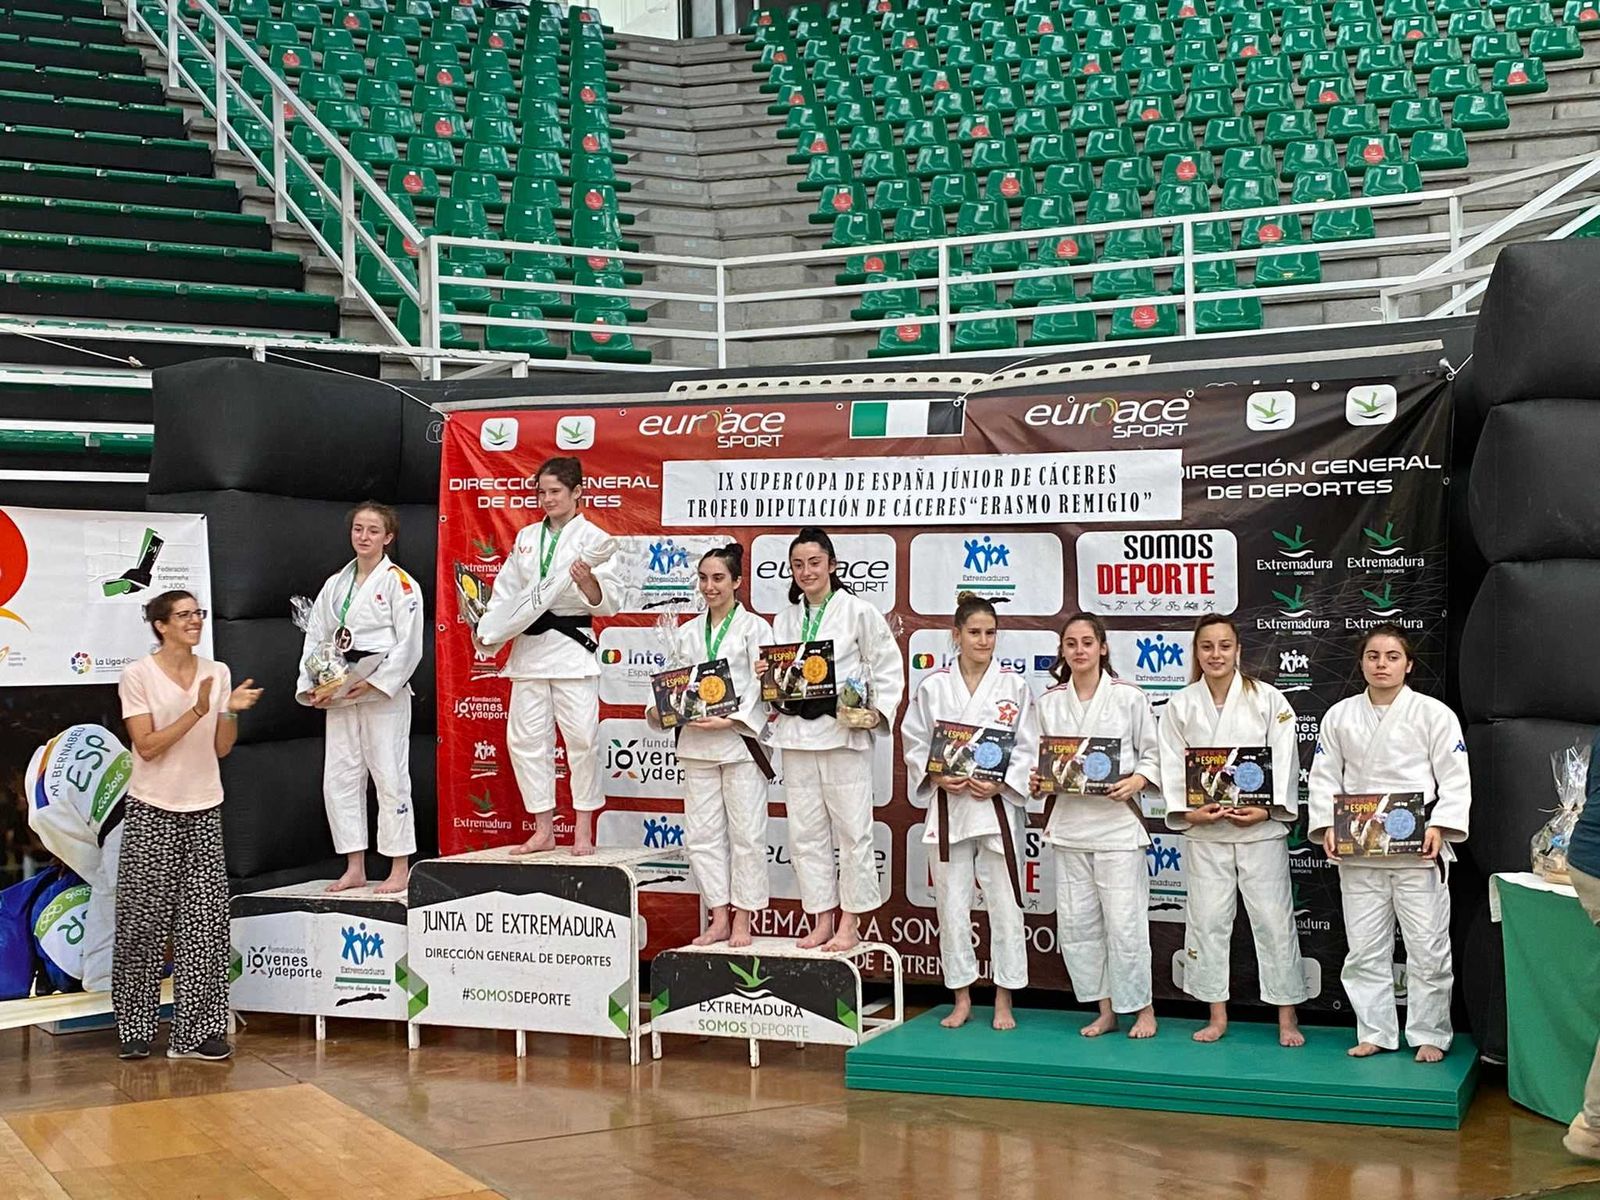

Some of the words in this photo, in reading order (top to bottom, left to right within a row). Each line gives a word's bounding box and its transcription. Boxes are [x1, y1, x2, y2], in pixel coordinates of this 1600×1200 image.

[1112, 421, 1189, 439] SPORT
[717, 434, 784, 449] SPORT
[1312, 455, 1441, 475] GENERAL
[450, 474, 538, 491] DIRECCIÓ
[582, 475, 659, 490] ENERAL
[718, 472, 734, 490] IX
[740, 472, 837, 491] SUPERCOPA
[845, 472, 866, 491] DE
[872, 468, 934, 491] ESPAÑA
[941, 467, 1003, 492] JÚNIOR
[1011, 467, 1031, 487] DE
[1039, 462, 1116, 486] CÁCERES
[1207, 484, 1243, 500] DE
[1248, 479, 1393, 498] DEPORTES
[478, 496, 505, 509] DE
[687, 499, 749, 518] TROFEO
[756, 495, 859, 518] DIPUTACIÓN
[866, 498, 887, 517] DE
[1124, 533, 1213, 560] SOMOS
[1256, 558, 1333, 570] Extremadura
[1347, 555, 1425, 568] Extremadura
[962, 574, 1010, 582] Extremadura
[1097, 562, 1216, 595] DEPORTE
[1256, 618, 1330, 630] Extremadura
[471, 711, 508, 720] ydeport
[453, 817, 512, 830] Extremadura
[423, 910, 467, 934] JUNTA
[476, 912, 493, 933] DE
[502, 913, 616, 939] EXTREMADURA
[425, 947, 484, 960] DIRECCIÓN
[487, 950, 536, 963] GENERAL
[539, 953, 553, 964] DE
[556, 954, 612, 967] DEPORTES
[856, 952, 874, 971] DE
[340, 966, 385, 976] Extremadura
[462, 987, 571, 1006] #SOMOSDEPORTE
[698, 1000, 804, 1018] EXTREMADURA
[698, 1019, 747, 1034] SOMOS
[750, 1021, 809, 1039] DEPORTE
